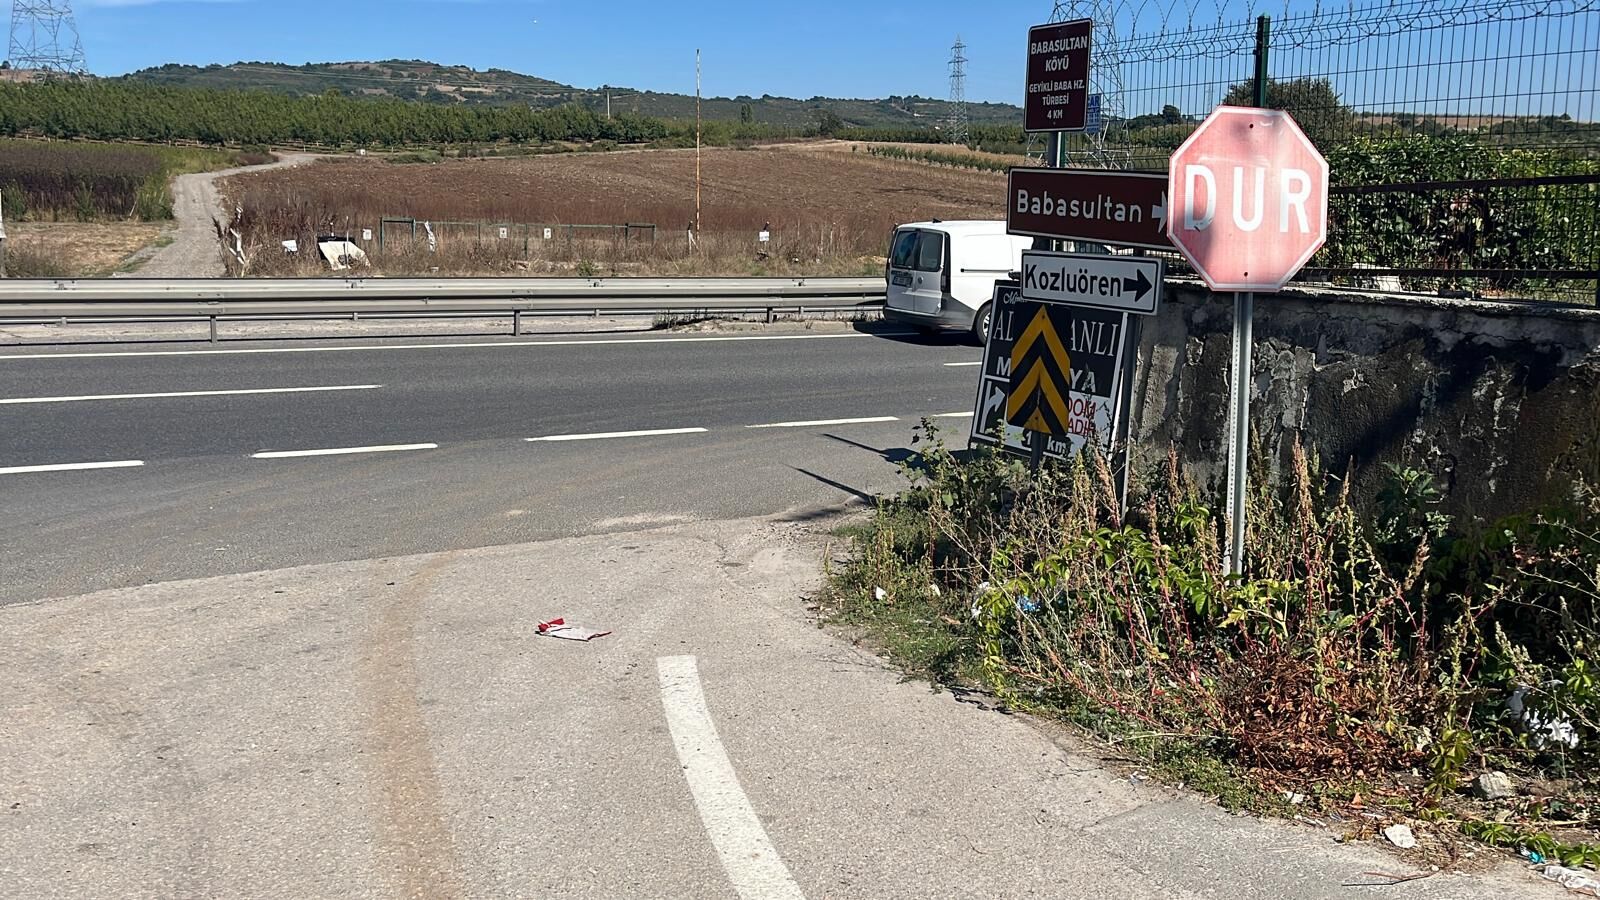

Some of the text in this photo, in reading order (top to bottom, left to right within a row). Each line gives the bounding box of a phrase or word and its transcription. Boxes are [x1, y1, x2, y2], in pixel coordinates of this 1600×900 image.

[1031, 36, 1088, 55] BABASULTAN
[1045, 55, 1069, 72] KÖYÜ
[1029, 80, 1085, 93] GEYİKLİ BABA HZ.
[1042, 93, 1069, 106] TÜRBESİ
[1047, 110, 1063, 119] 4 KM
[1017, 189, 1142, 223] Babasultan
[1184, 164, 1312, 234] DUR
[1025, 264, 1121, 298] Kozluören
